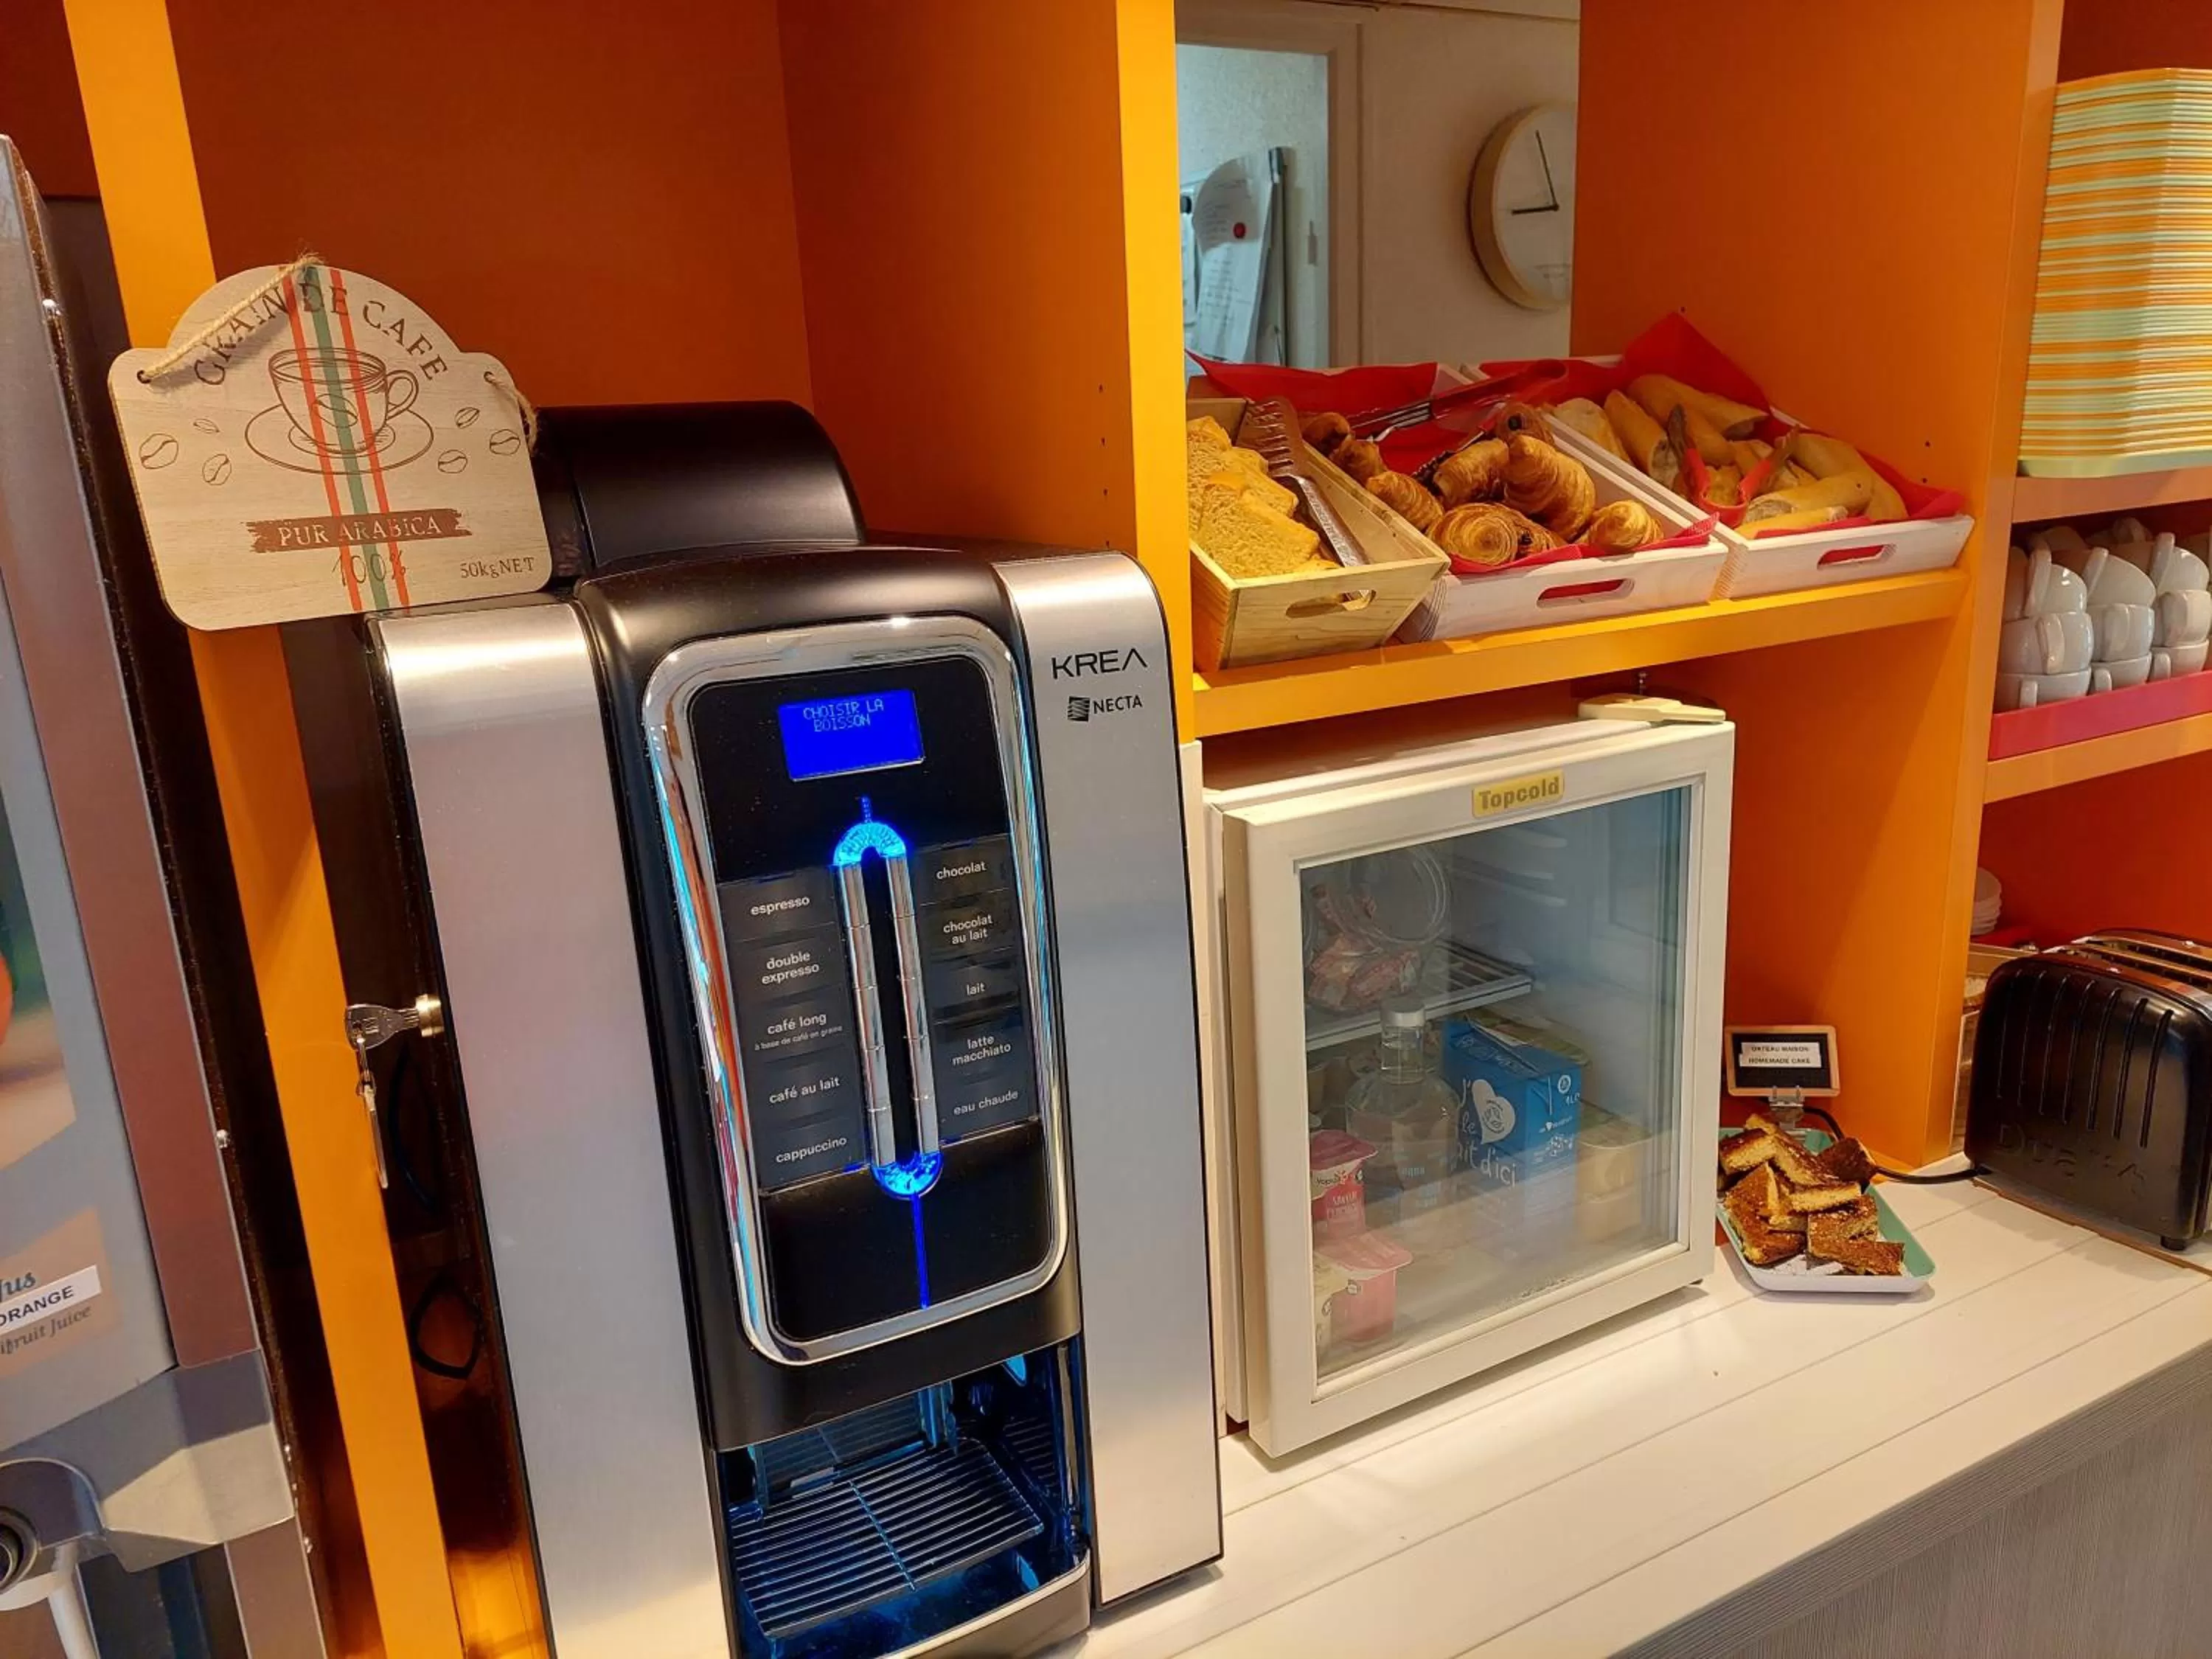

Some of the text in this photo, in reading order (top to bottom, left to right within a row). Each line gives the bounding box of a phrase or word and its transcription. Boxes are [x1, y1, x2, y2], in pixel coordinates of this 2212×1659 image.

[276, 515, 443, 547] PUR ARABICA
[1051, 647, 1148, 680] KREA
[802, 698, 884, 720] CHOISIR LA
[1092, 694, 1143, 714] NECTA
[813, 712, 872, 732] BOISSON
[1478, 776, 1560, 810] Topcold
[936, 860, 988, 880] chocolat
[750, 896, 811, 916] espresso
[942, 913, 993, 933] chocolat
[951, 928, 989, 945] au lait
[766, 950, 811, 970] double
[761, 963, 820, 985] expresso
[966, 982, 986, 996] lait
[767, 1013, 827, 1035] café long
[967, 1035, 995, 1050] latte
[951, 1043, 1012, 1066] macchiato
[768, 1077, 841, 1105] café au lait
[953, 1090, 1019, 1116] eau chaude
[775, 1136, 848, 1164] cappuccino
[49, 1305, 93, 1338] Juice
